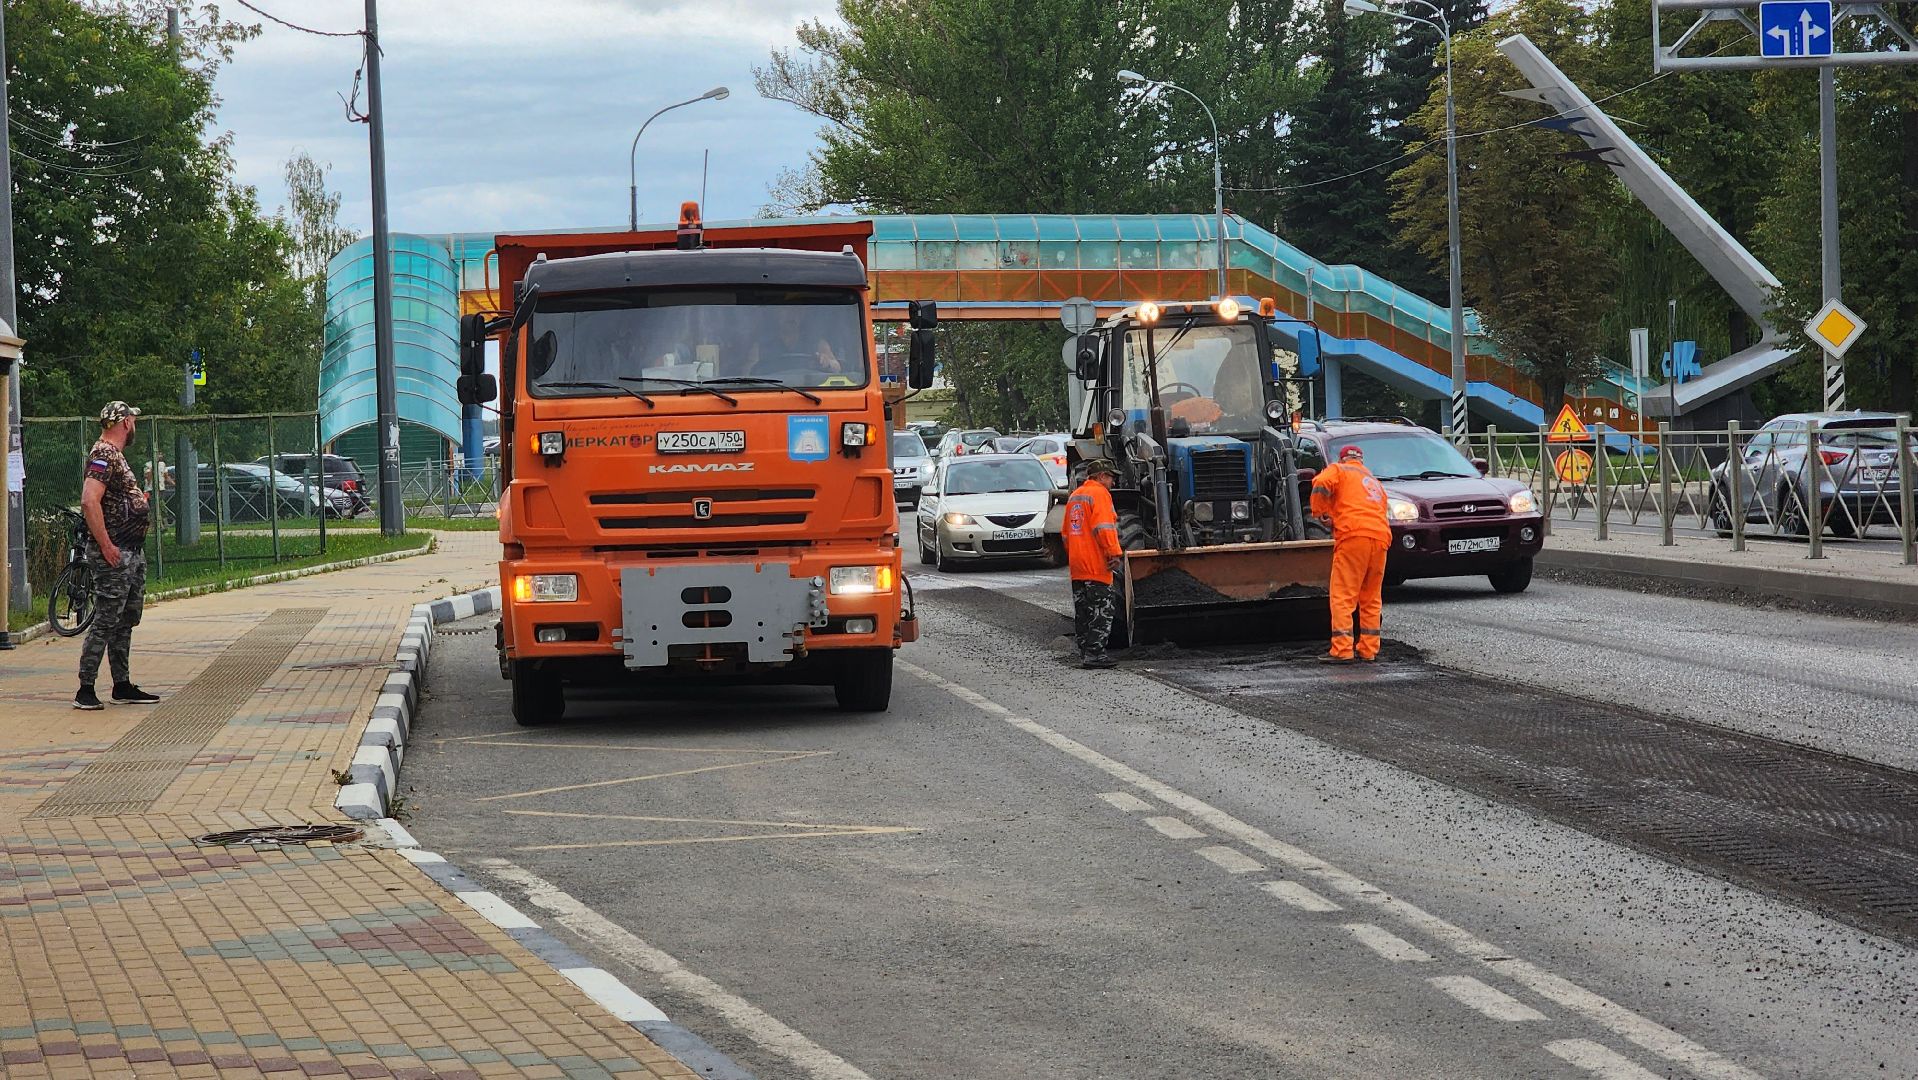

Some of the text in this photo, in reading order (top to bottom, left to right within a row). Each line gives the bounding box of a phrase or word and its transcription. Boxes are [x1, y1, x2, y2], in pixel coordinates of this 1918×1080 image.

[662, 432, 740, 448] У250СА 750
[648, 462, 755, 474] KAMAZ
[1450, 540, 1484, 551] М672МС
[1485, 537, 1498, 545] 197
